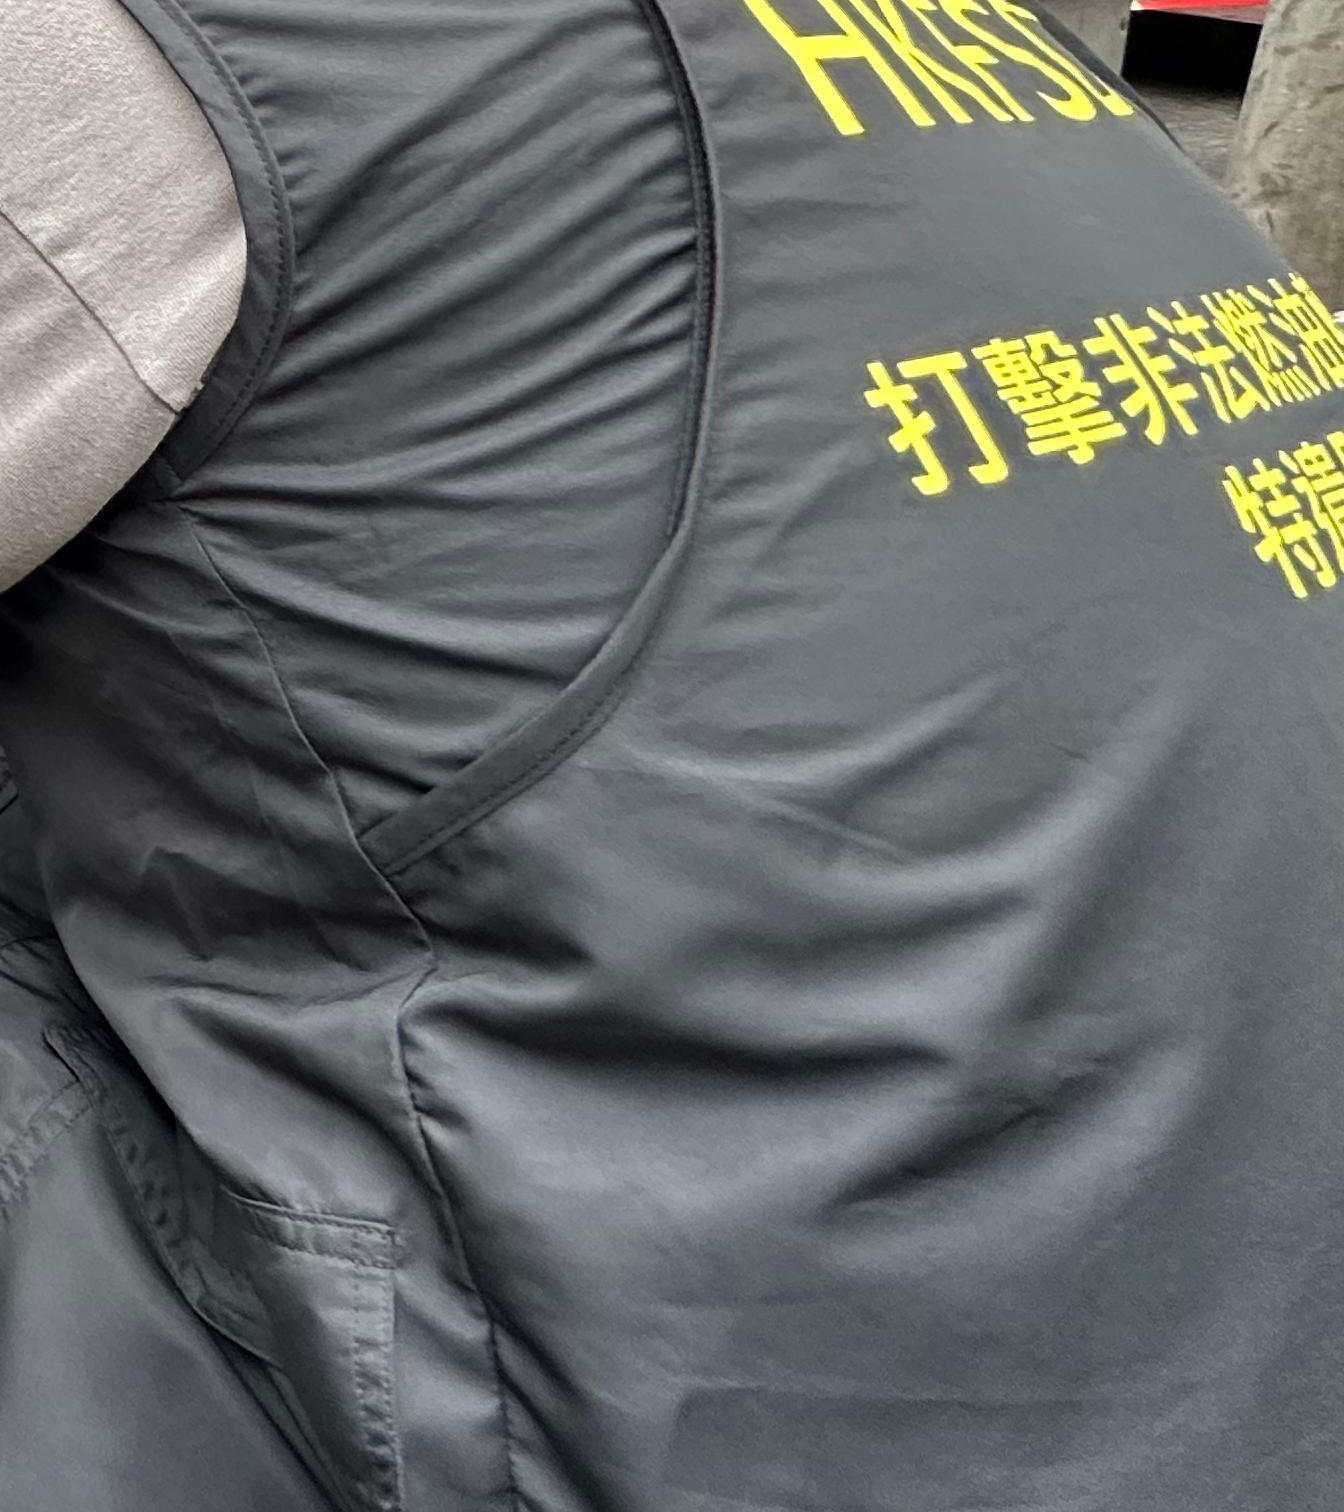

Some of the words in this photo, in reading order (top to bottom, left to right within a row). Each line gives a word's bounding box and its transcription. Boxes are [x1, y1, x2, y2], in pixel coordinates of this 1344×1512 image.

[864, 273, 1344, 496] 打擊非法燃油
